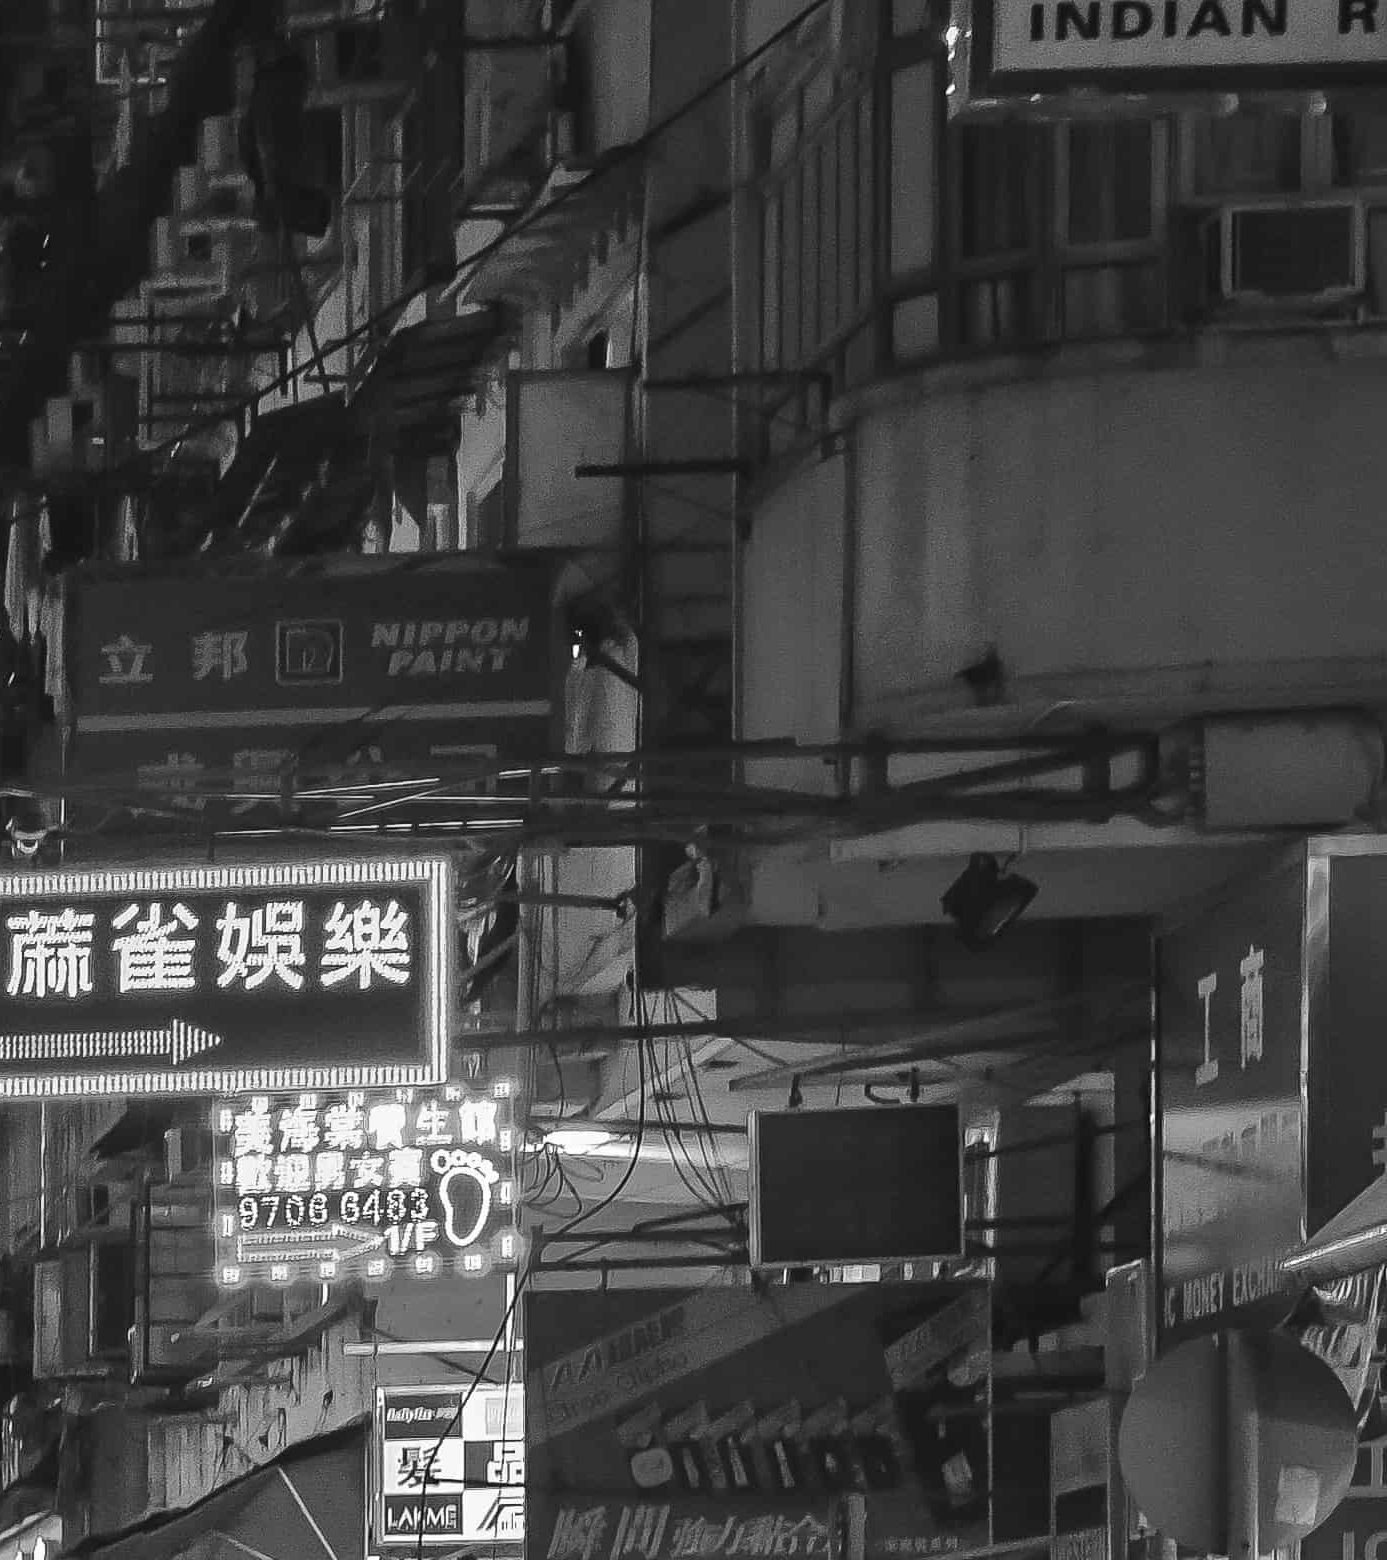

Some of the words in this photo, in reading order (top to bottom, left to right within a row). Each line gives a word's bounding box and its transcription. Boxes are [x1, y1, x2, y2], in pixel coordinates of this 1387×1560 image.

[369, 616, 530, 649] NIPPON
[98, 628, 251, 685] 立邦
[385, 645, 514, 677] PAINT
[384, 1220, 439, 1256] 1/F
[1182, 1271, 1225, 1321] MONEY
